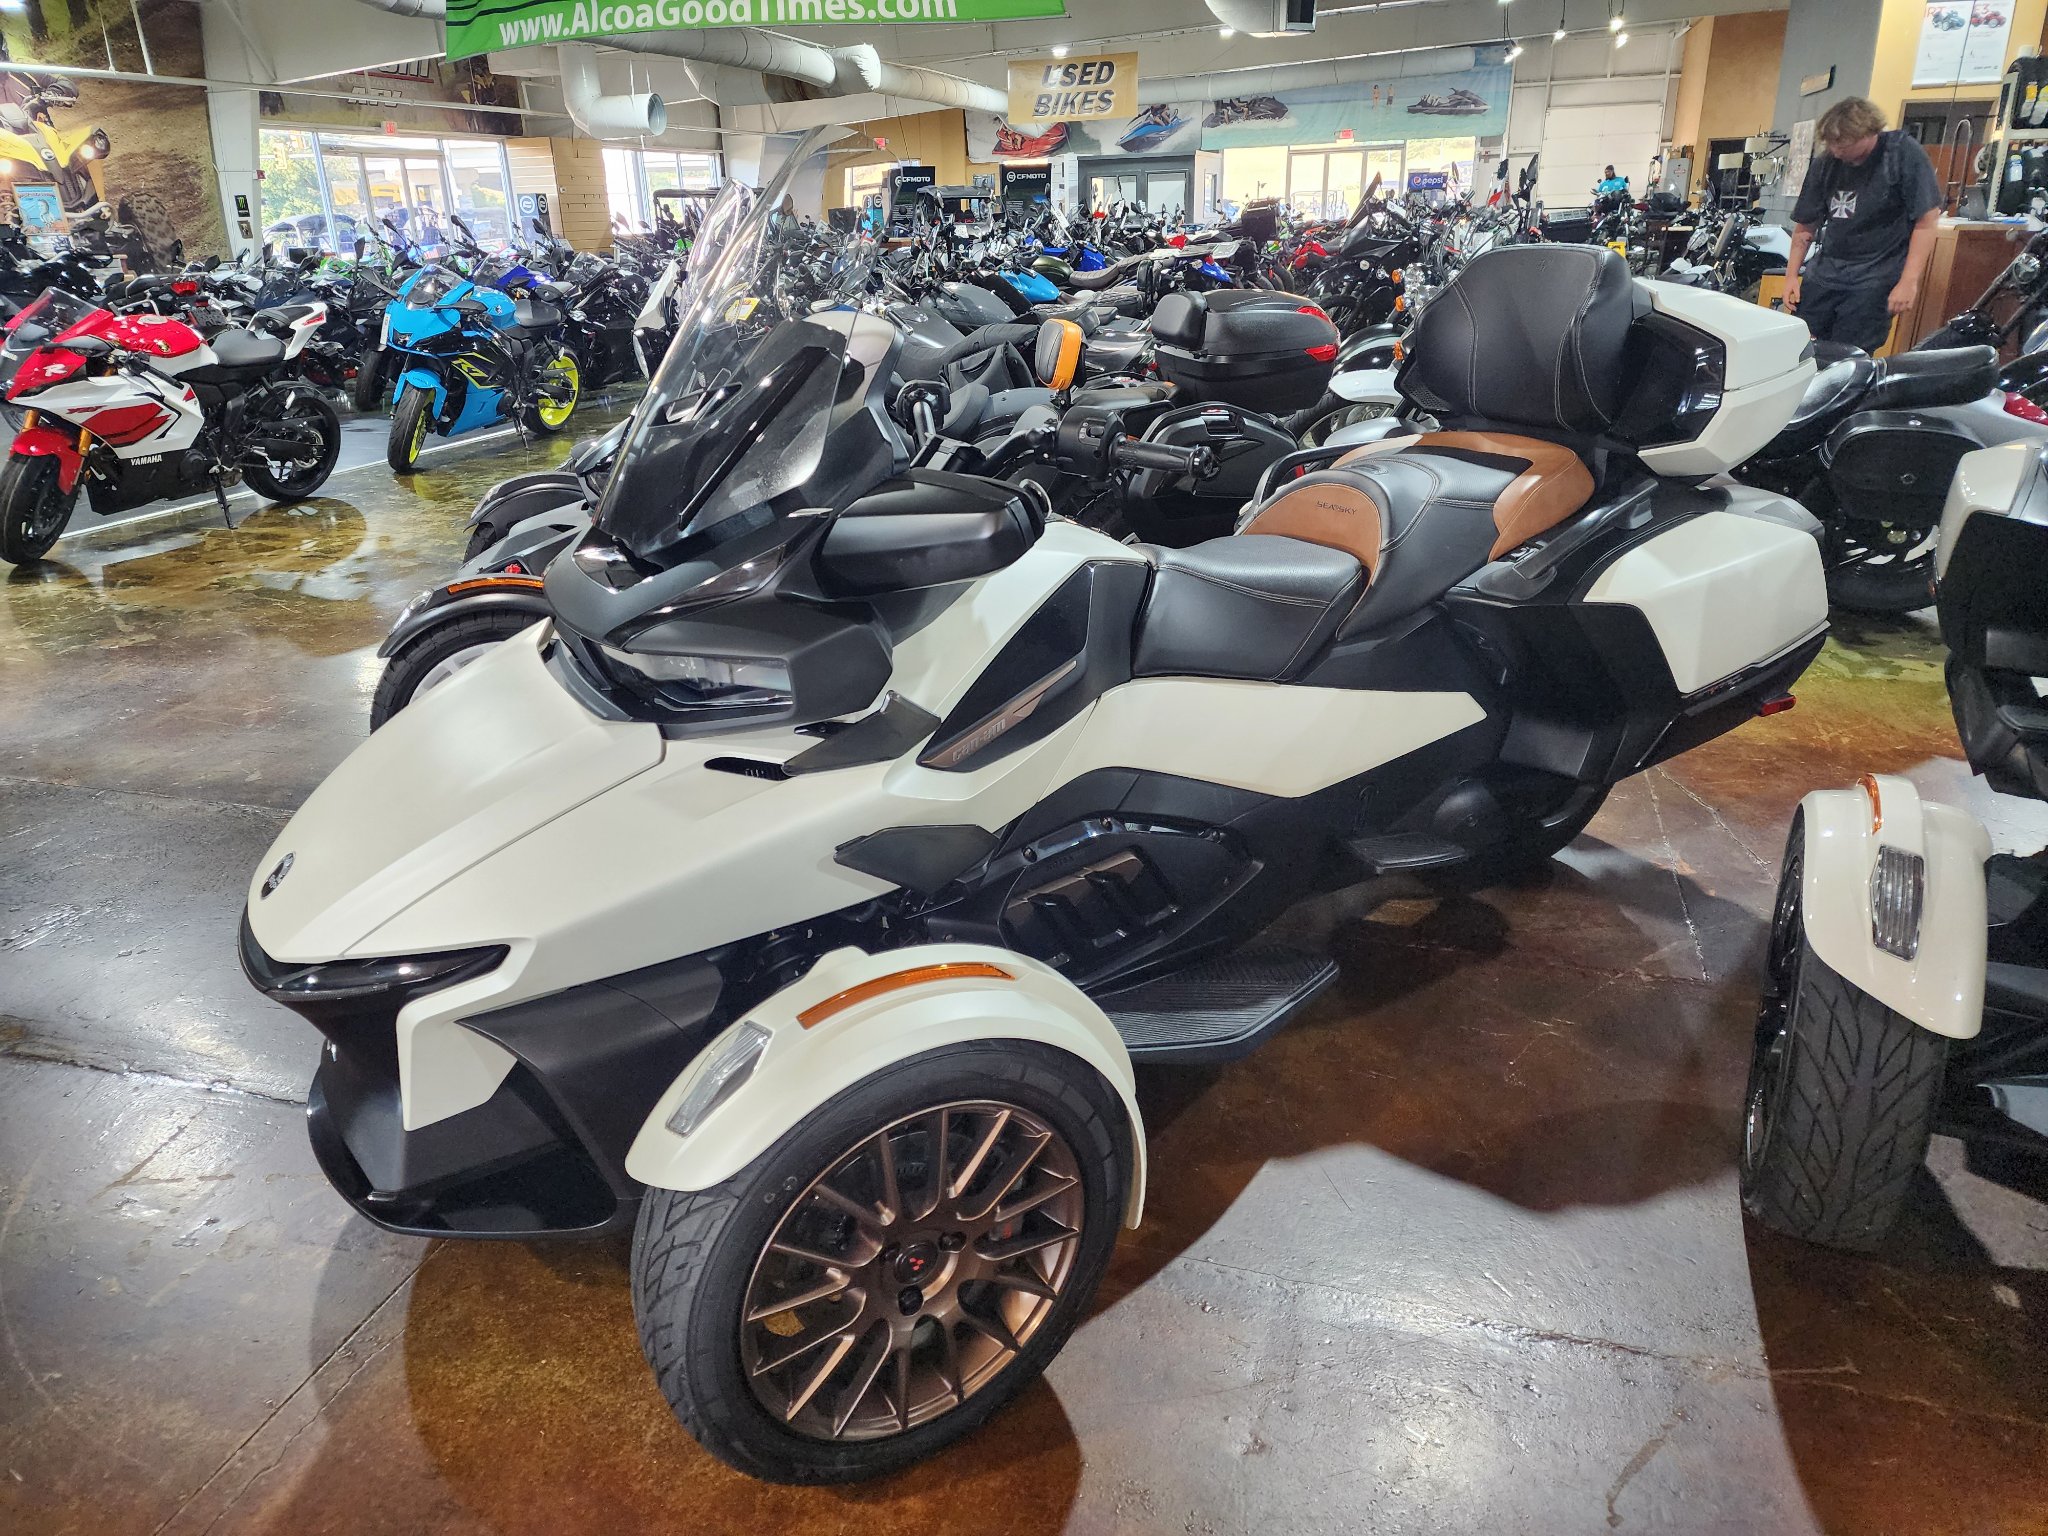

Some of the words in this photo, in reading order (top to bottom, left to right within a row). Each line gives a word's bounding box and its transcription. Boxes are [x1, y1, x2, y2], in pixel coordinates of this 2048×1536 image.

[498, 0, 958, 46] www.AlcoaGoodTimes.com
[1042, 61, 1115, 87] USED
[1032, 89, 1115, 117] BIKES
[130, 454, 163, 466] YAMAHA
